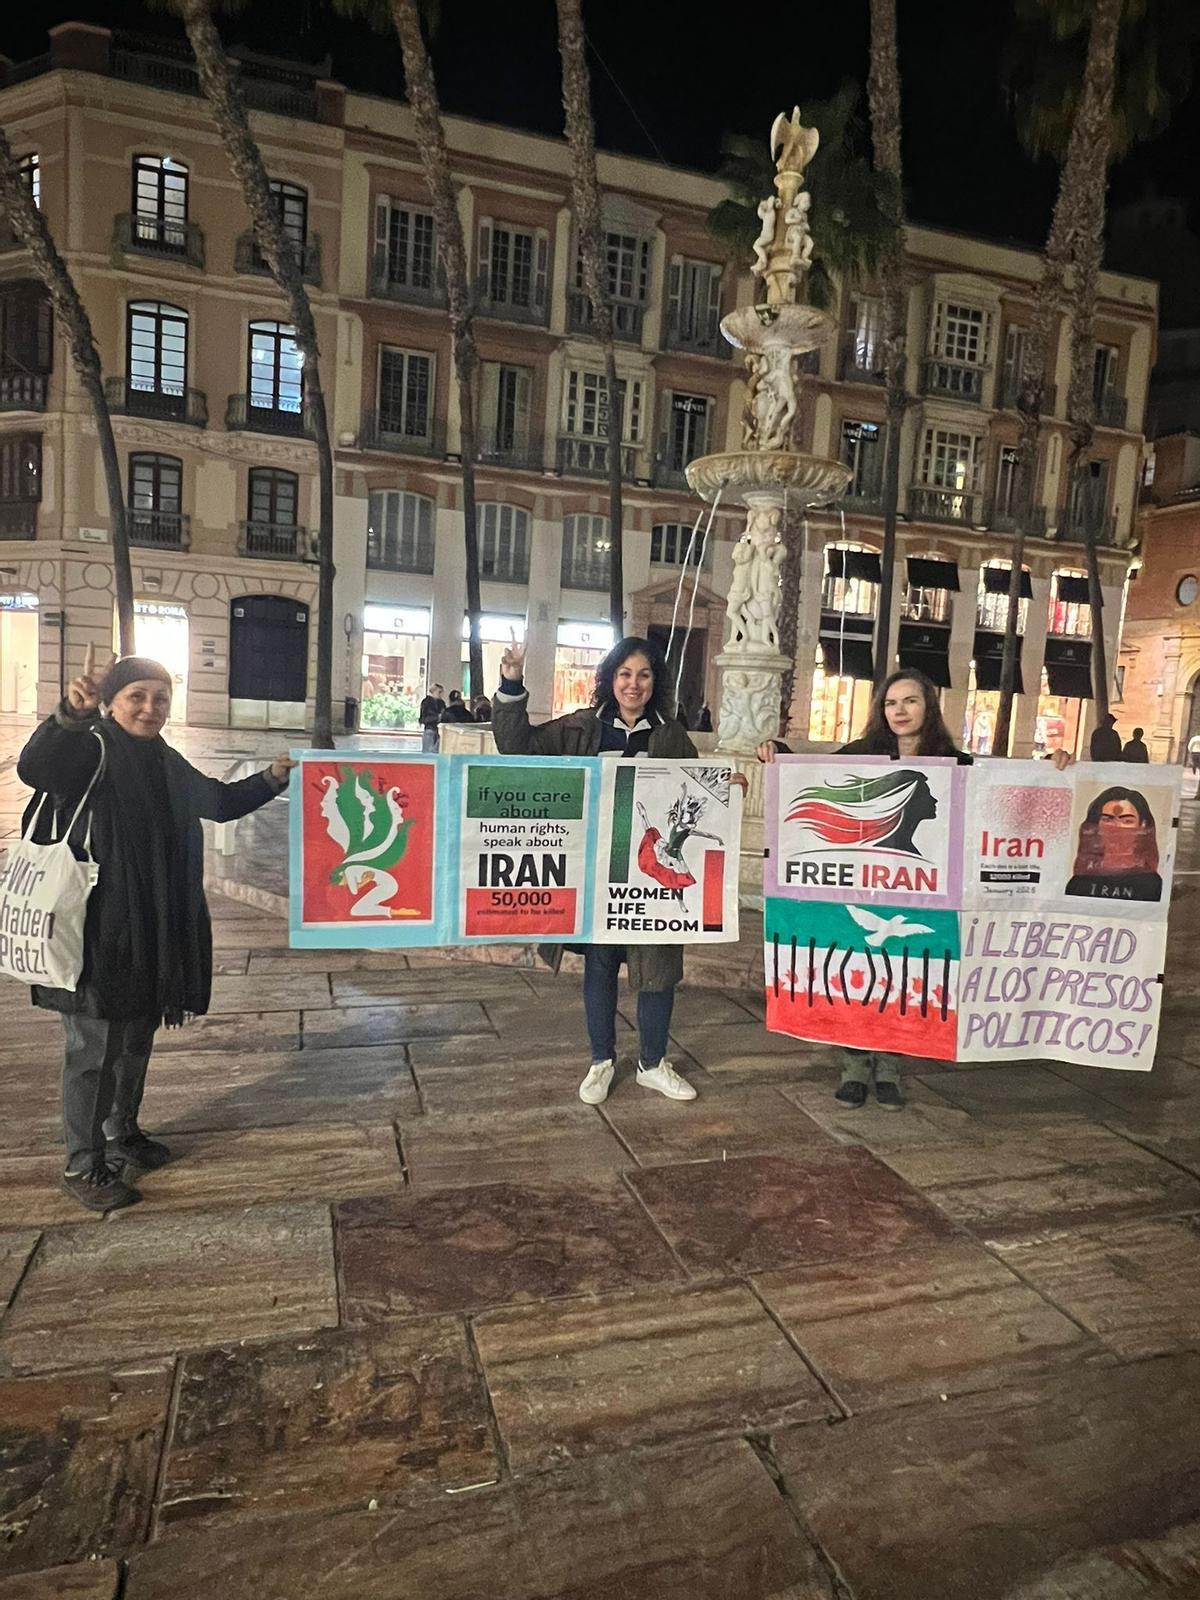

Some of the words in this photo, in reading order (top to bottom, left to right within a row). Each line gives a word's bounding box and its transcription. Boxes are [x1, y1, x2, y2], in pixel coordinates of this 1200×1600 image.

[478, 787, 490, 801] if
[495, 791, 526, 804] you
[532, 792, 571, 803] care
[500, 804, 550, 819] about
[479, 822, 526, 833] human
[530, 823, 570, 836] rights,
[483, 836, 522, 848] speak
[526, 837, 563, 847] about
[981, 831, 1044, 858] Iran
[478, 854, 566, 887] IRAN
[786, 861, 854, 886] FREE
[862, 864, 938, 891] IRAN
[608, 887, 684, 900] WOMEN
[1090, 883, 1133, 897] IRAN
[491, 891, 552, 908] 50,000
[0, 894, 56, 940] haben
[607, 902, 646, 915] LIFE
[606, 918, 698, 932] FREEDOM
[965, 918, 1137, 964] ¡LIBERAD
[0, 933, 48, 975] Platz!
[984, 966, 1037, 1002] LOS
[1039, 966, 1158, 1012] PRESOS
[963, 1010, 1153, 1058] POLITICOS!
